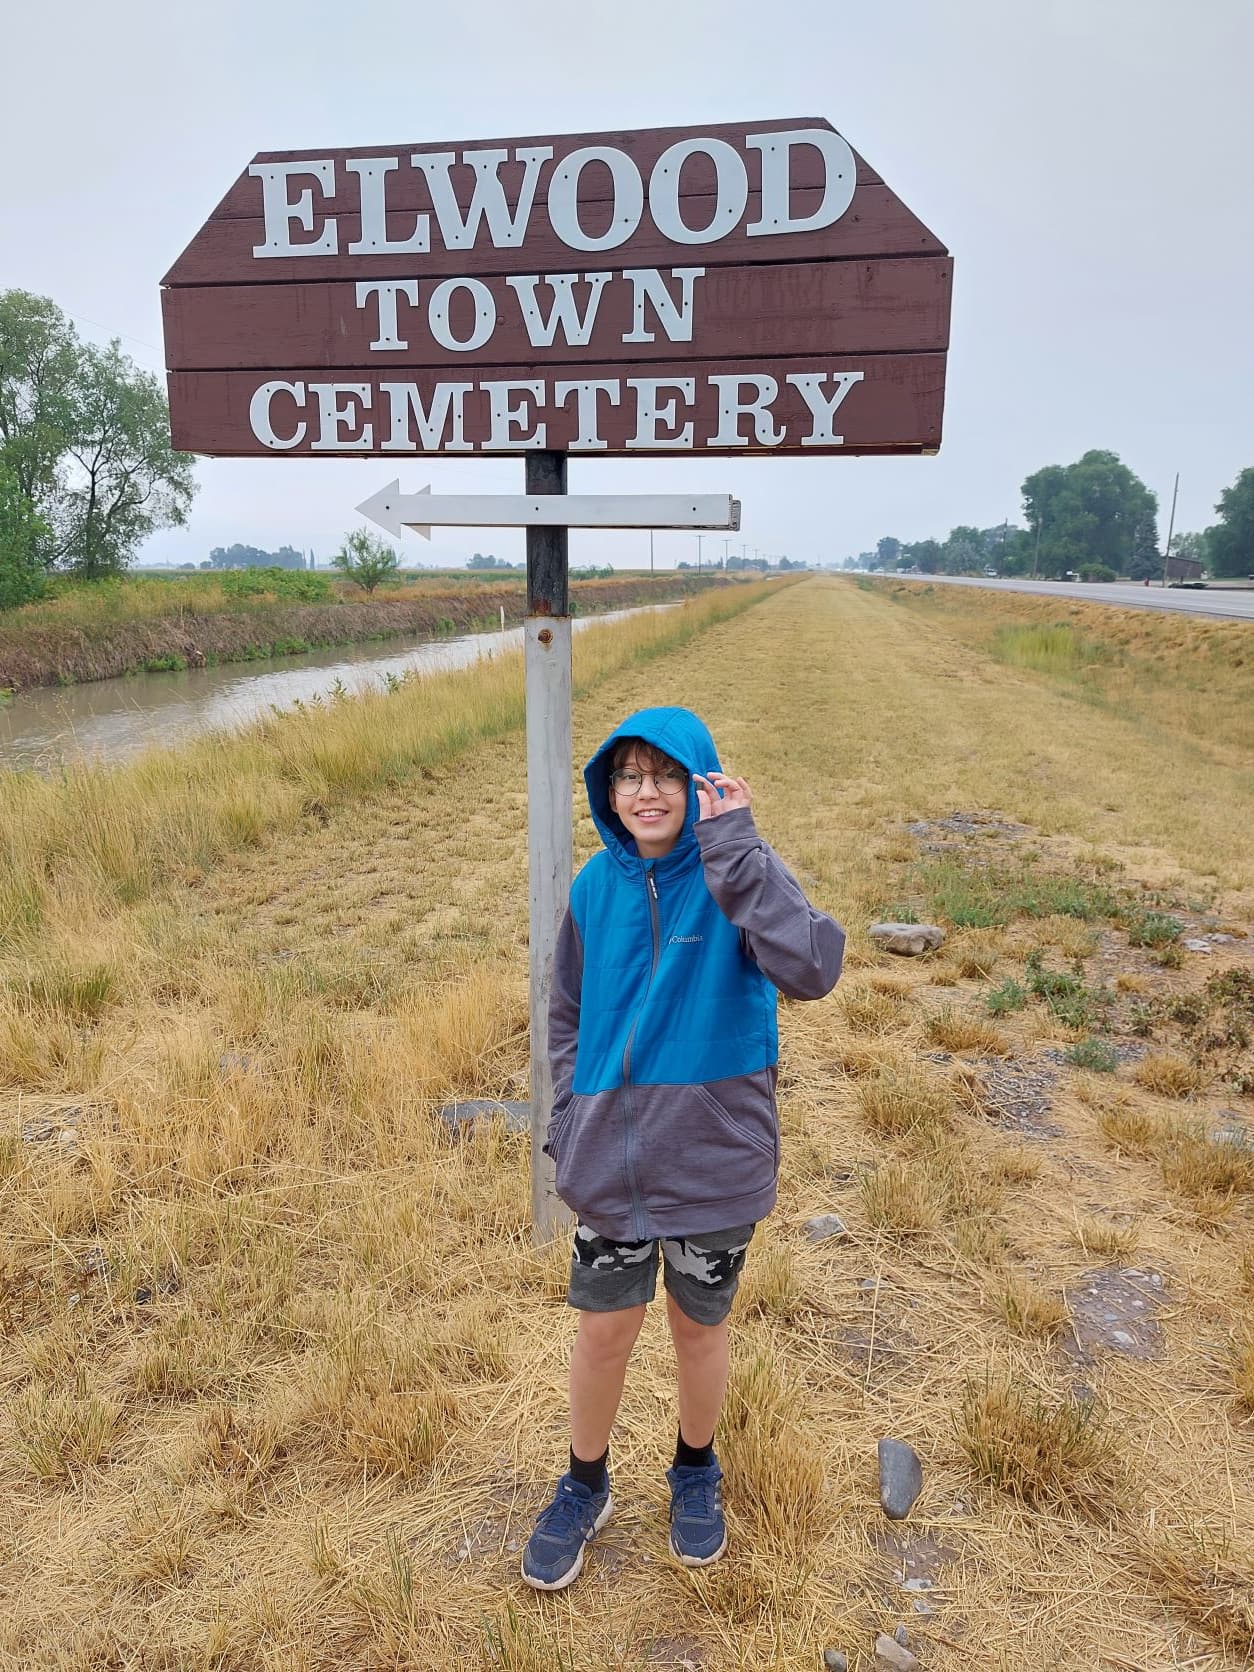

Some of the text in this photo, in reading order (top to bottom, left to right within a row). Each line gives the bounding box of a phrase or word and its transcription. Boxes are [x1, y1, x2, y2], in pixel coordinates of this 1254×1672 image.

[248, 129, 857, 258] ELWOOD
[355, 267, 706, 351] TOWN
[248, 372, 864, 451] CEMETERY
